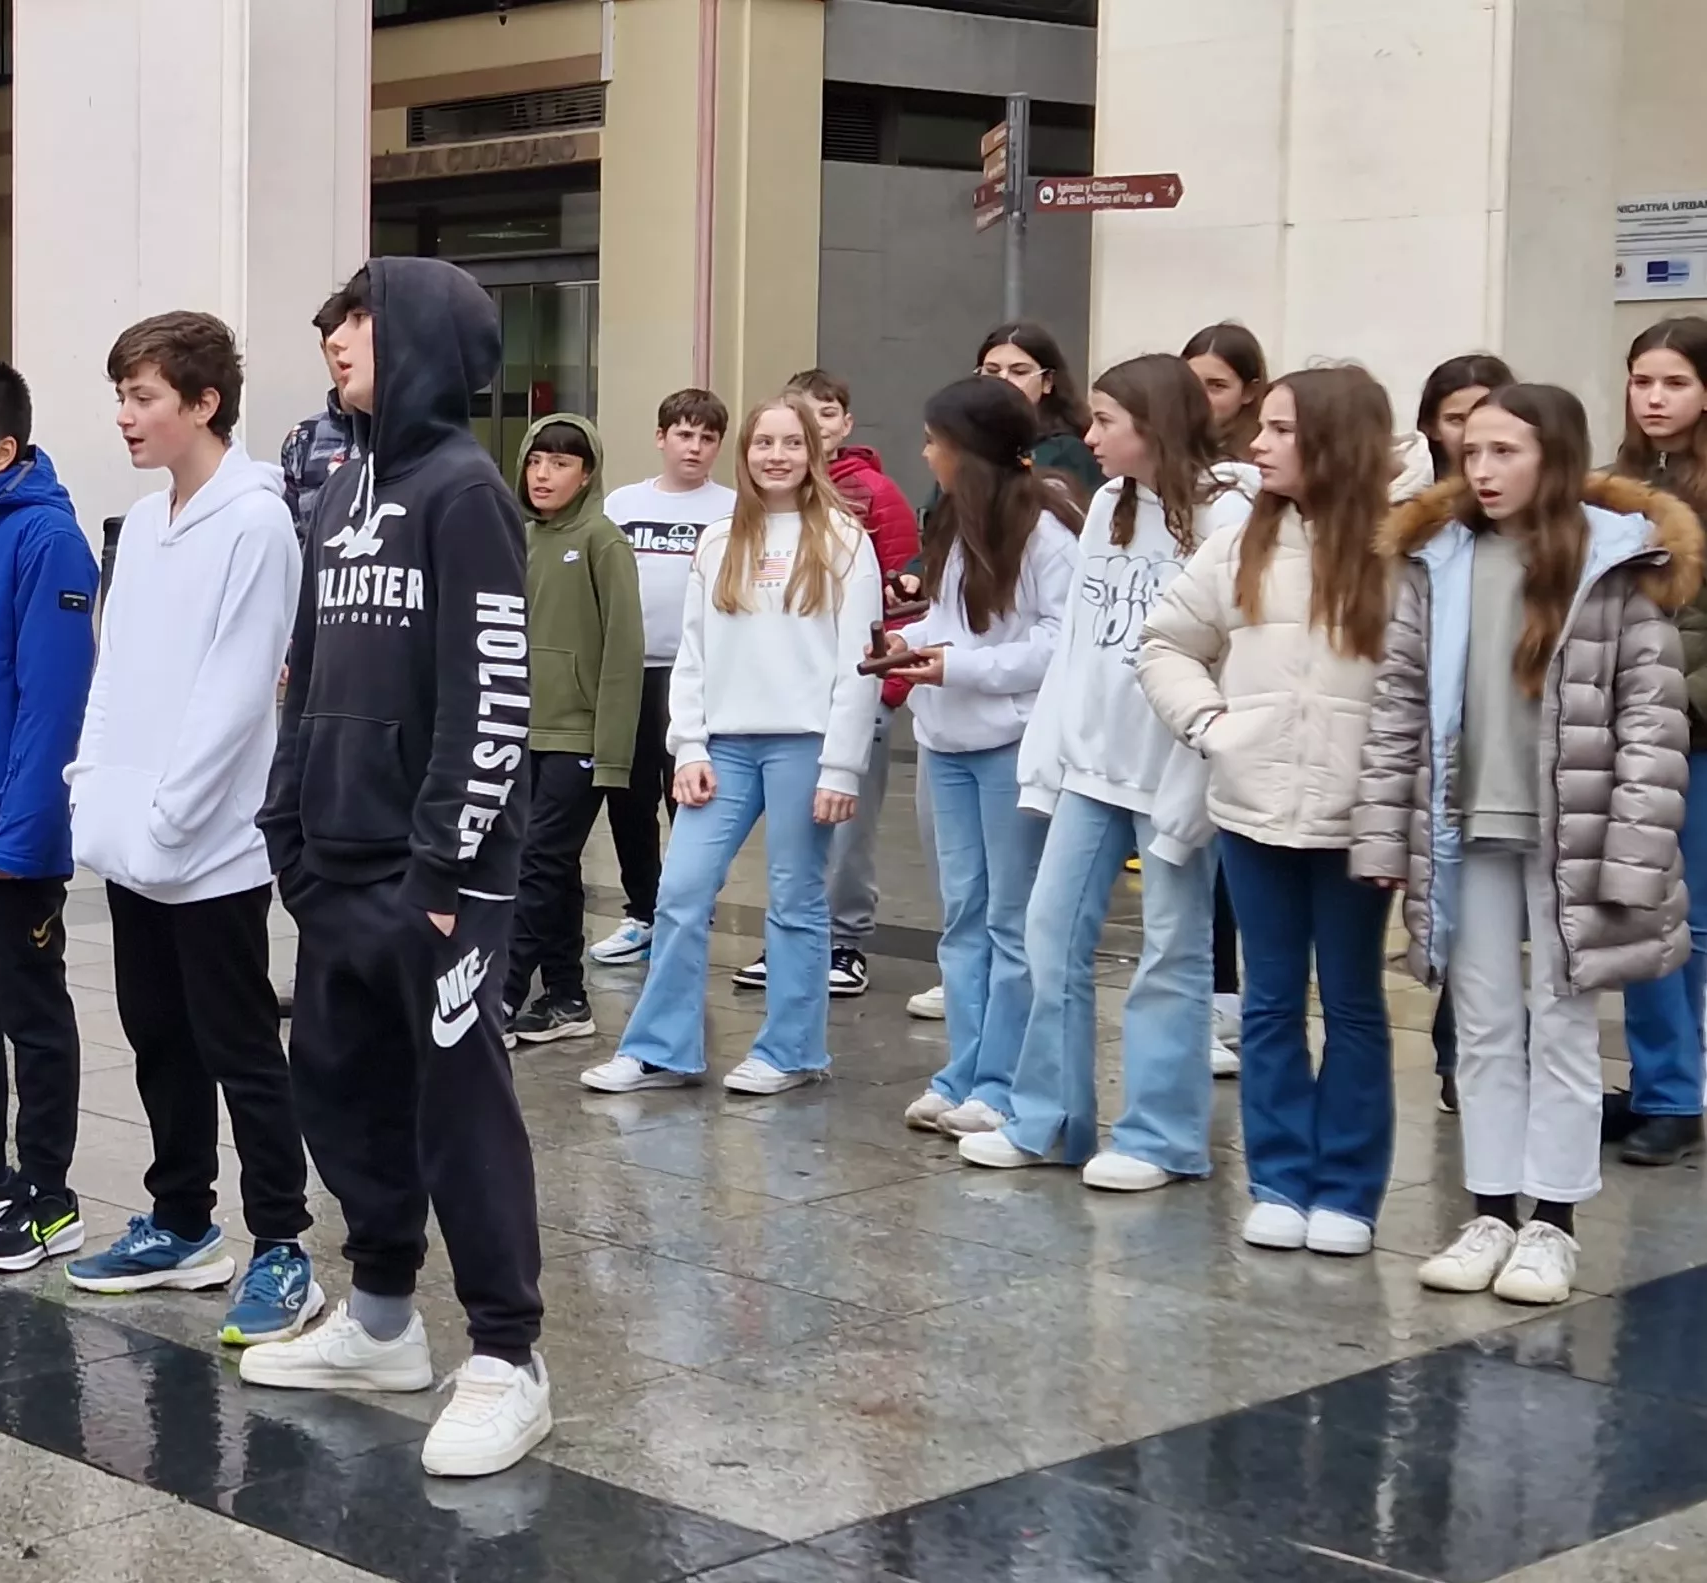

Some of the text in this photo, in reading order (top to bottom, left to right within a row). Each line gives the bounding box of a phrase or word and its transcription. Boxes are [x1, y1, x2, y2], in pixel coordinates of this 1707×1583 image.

[1069, 194, 1086, 205] San
[1087, 193, 1112, 204] Pedro
[1122, 191, 1143, 205] Viejo
[458, 592, 531, 860] HOLLISTER
